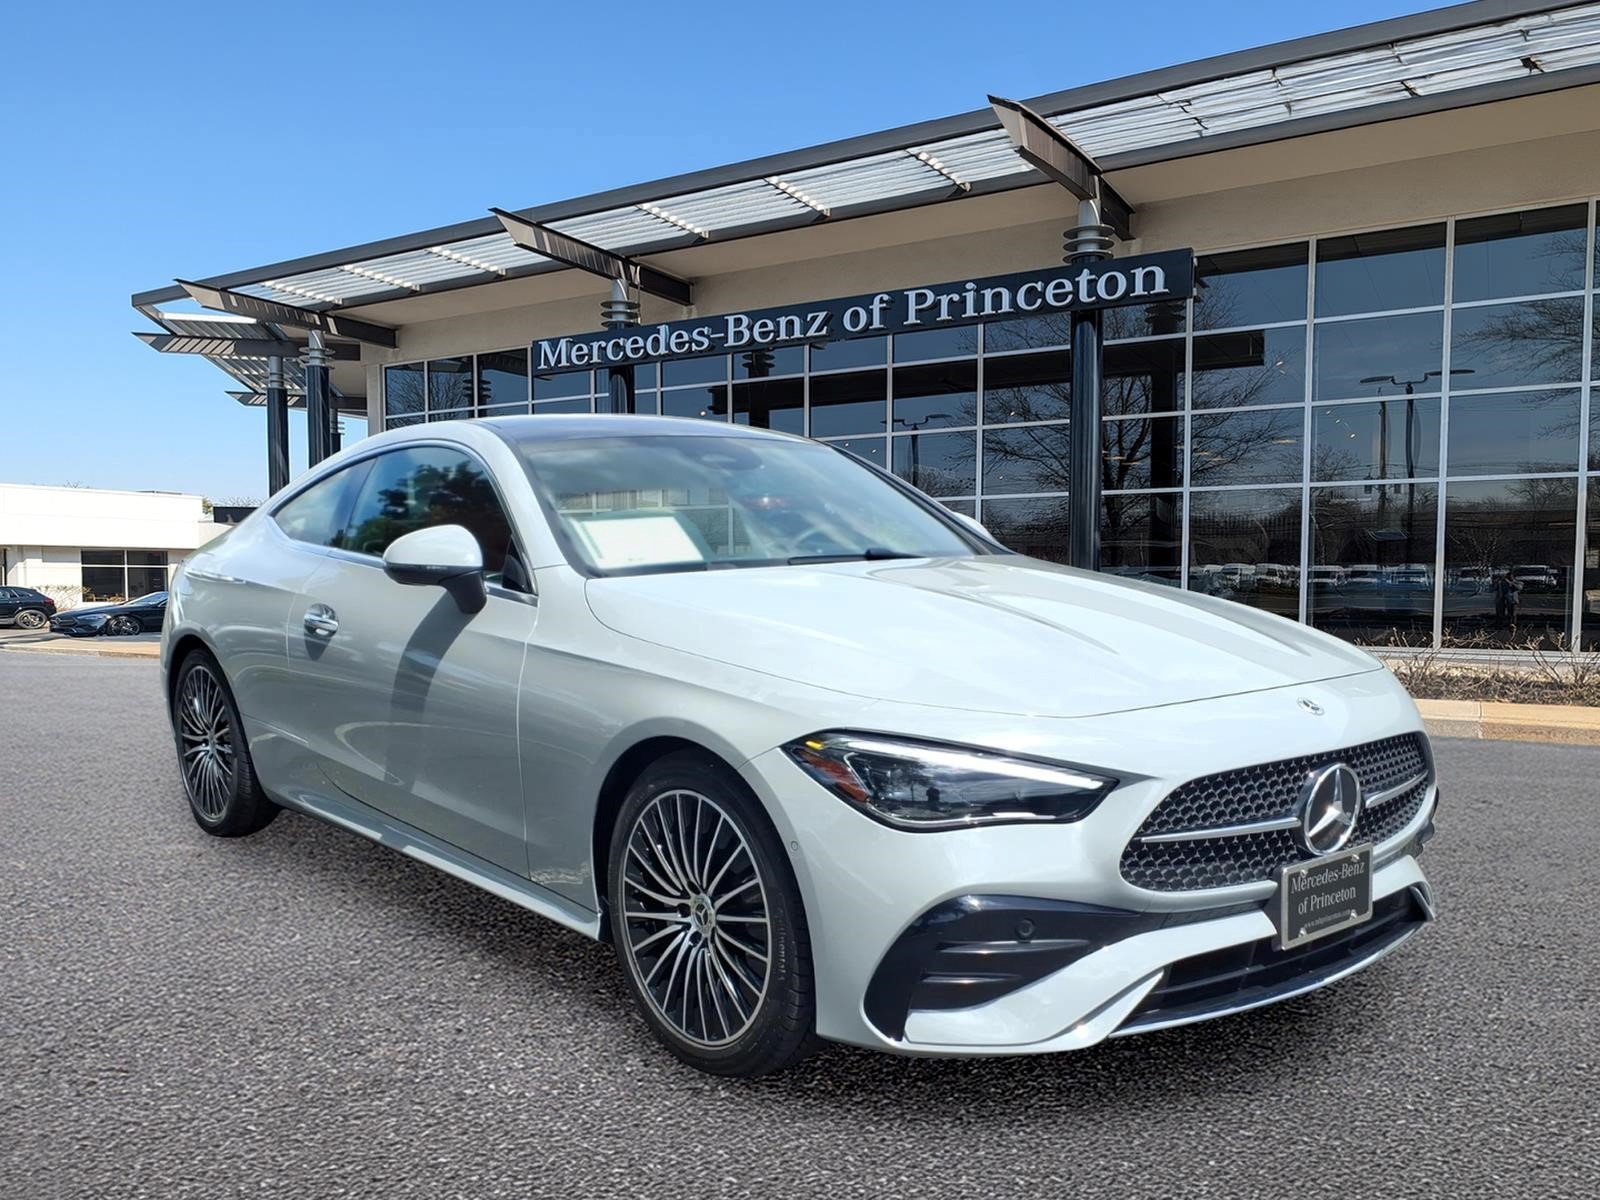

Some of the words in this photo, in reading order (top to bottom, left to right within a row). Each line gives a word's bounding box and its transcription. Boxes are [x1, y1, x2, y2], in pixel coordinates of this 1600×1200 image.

[537, 310, 829, 370] Mercedes-Benz
[842, 293, 890, 333] of
[902, 264, 1169, 325] Princeton
[1290, 862, 1365, 894] Mercedes-Benz
[1298, 896, 1309, 915] of
[1310, 886, 1357, 911] Princeton
